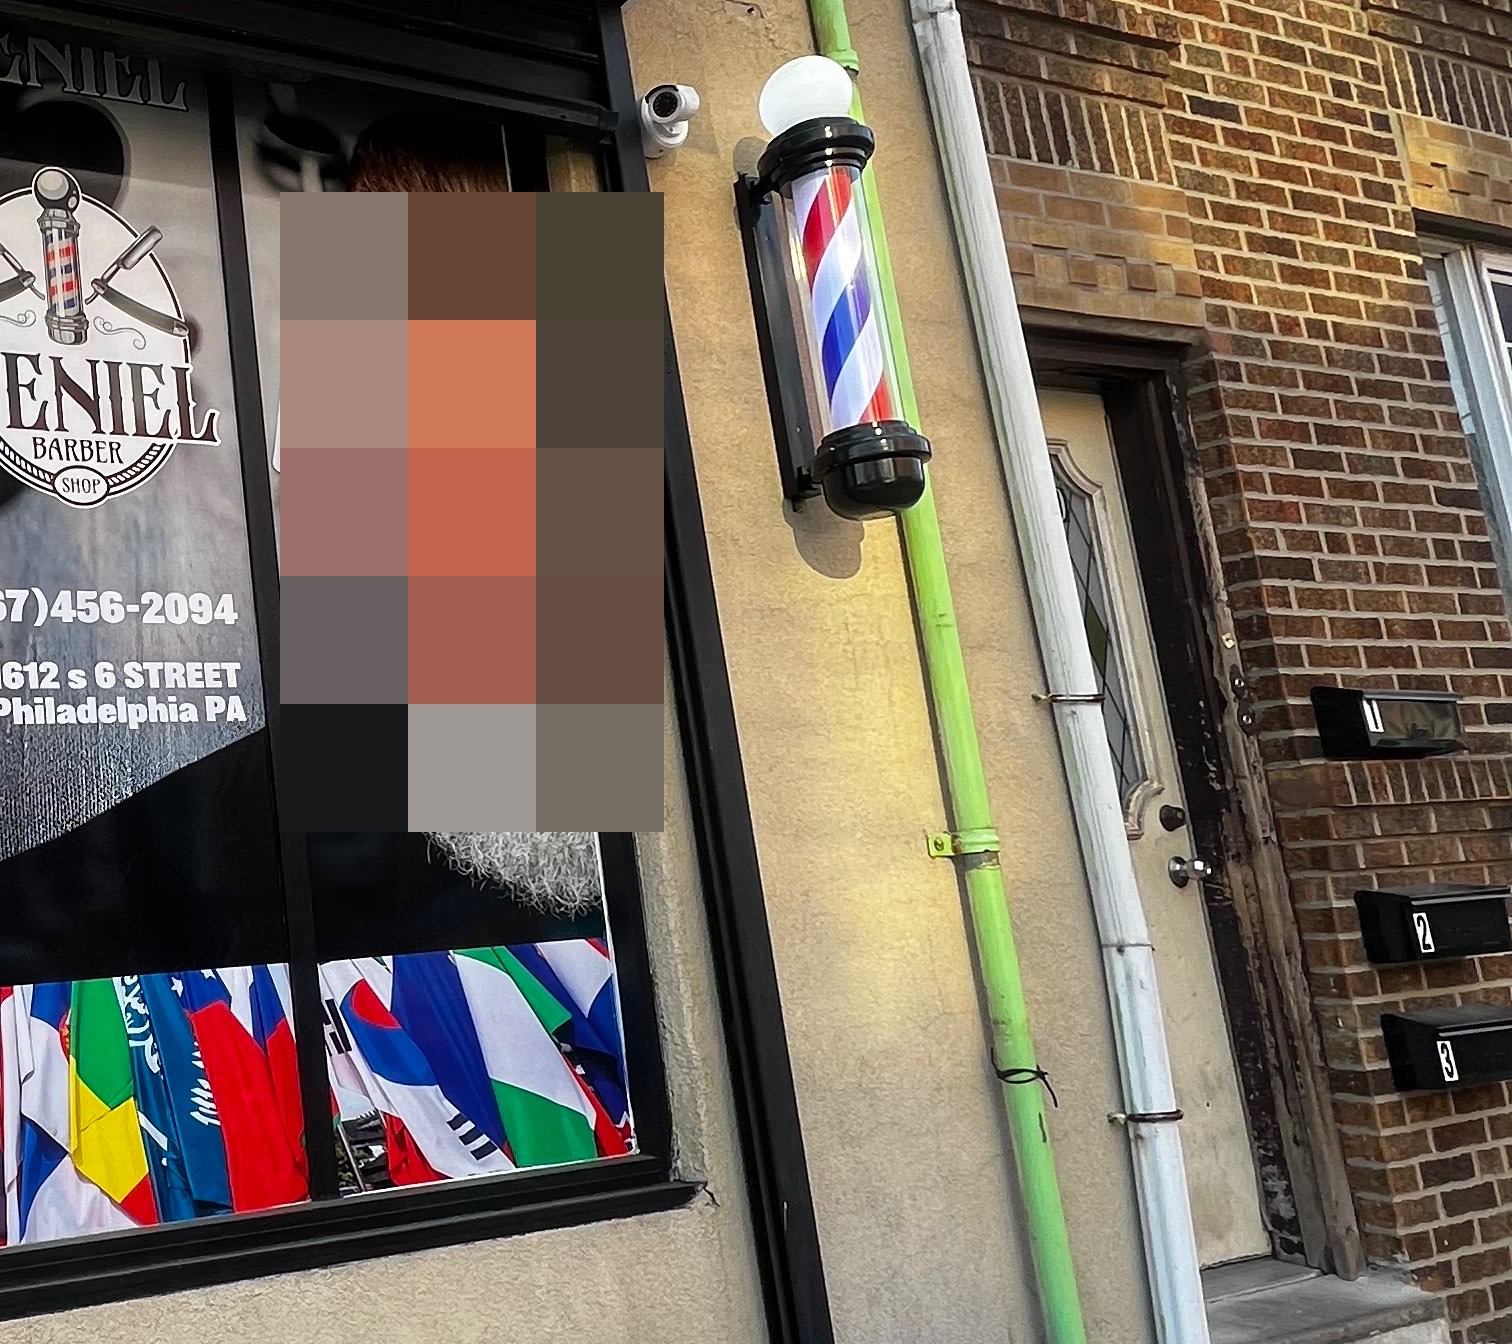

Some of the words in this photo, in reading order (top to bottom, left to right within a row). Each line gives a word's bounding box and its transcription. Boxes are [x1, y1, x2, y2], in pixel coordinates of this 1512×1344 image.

[31, 435, 125, 465] BARBER
[62, 475, 102, 496] SHOP
[67, 668, 87, 689] s
[95, 662, 116, 689] 6
[125, 662, 241, 689] STREET
[206, 696, 247, 723] PA
[1416, 914, 1433, 951] 2
[1440, 1042, 1455, 1079] 3
